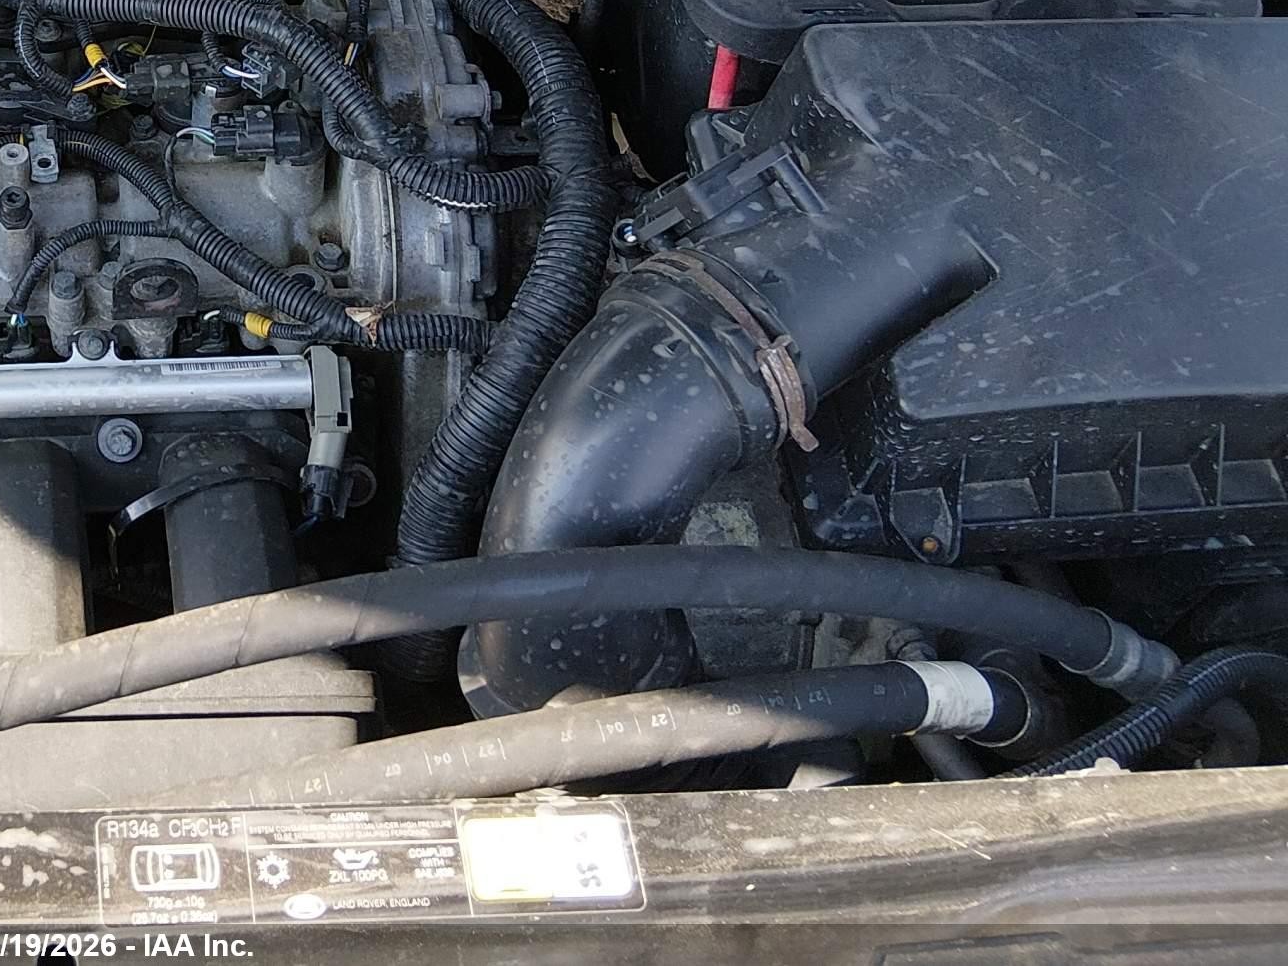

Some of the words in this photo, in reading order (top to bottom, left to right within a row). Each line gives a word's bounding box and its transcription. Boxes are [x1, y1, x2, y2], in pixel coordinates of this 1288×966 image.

[809, 690, 824, 703] 27
[726, 703, 741, 716] 07
[651, 713, 668, 728] 27
[606, 721, 624, 734] 04
[479, 744, 496, 758] 27
[434, 752, 452, 766] 04
[385, 763, 401, 778] 07
[304, 777, 322, 794] 27
[329, 812, 369, 822] CAUTION
[107, 819, 160, 838] R134a
[409, 847, 454, 858] COMPLIES
[420, 857, 445, 867] WITH
[329, 870, 351, 883] ZXL
[333, 900, 355, 909] LAND
[357, 899, 389, 909] ROVER,
[390, 897, 431, 907] ENGLAND
